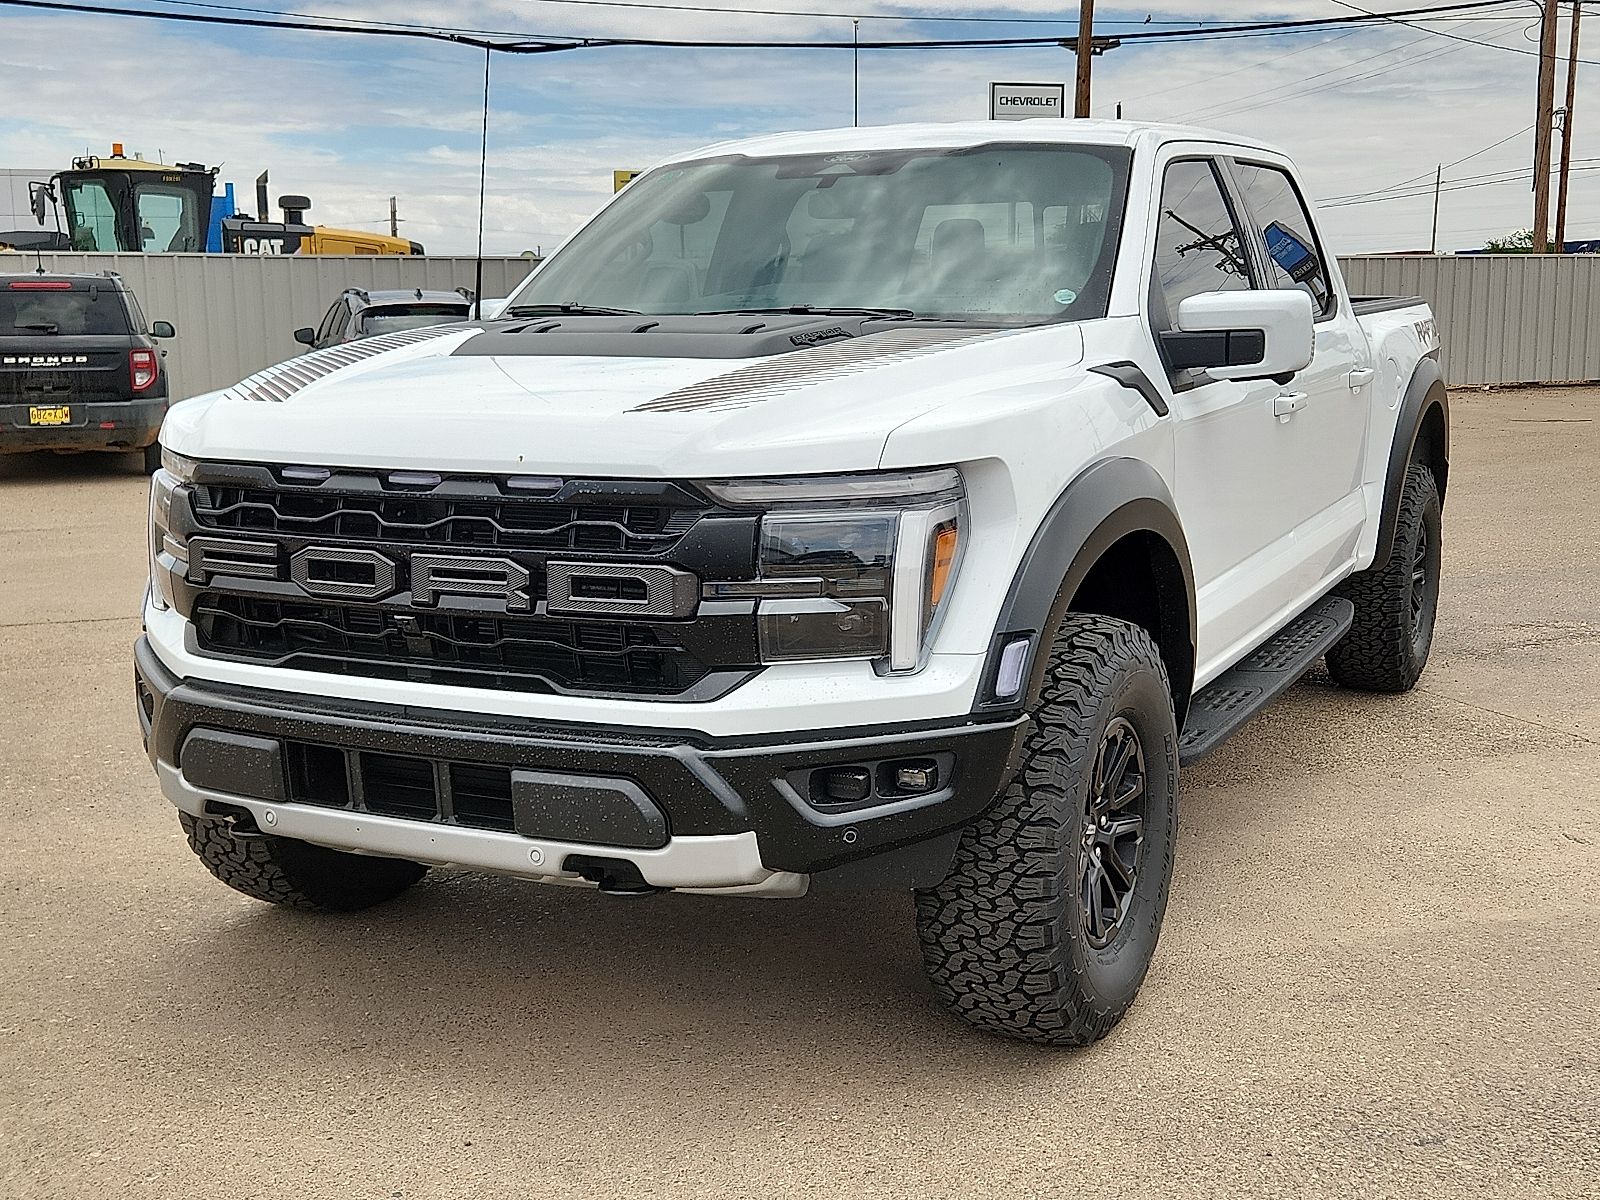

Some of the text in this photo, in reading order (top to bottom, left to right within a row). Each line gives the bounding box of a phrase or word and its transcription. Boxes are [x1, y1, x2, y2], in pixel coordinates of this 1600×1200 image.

[999, 96, 1059, 107] CHEVROLET
[243, 238, 284, 256] CAT
[790, 326, 842, 346] RAPTOR
[3, 356, 88, 364] BRONCO
[186, 535, 701, 624] FORD
